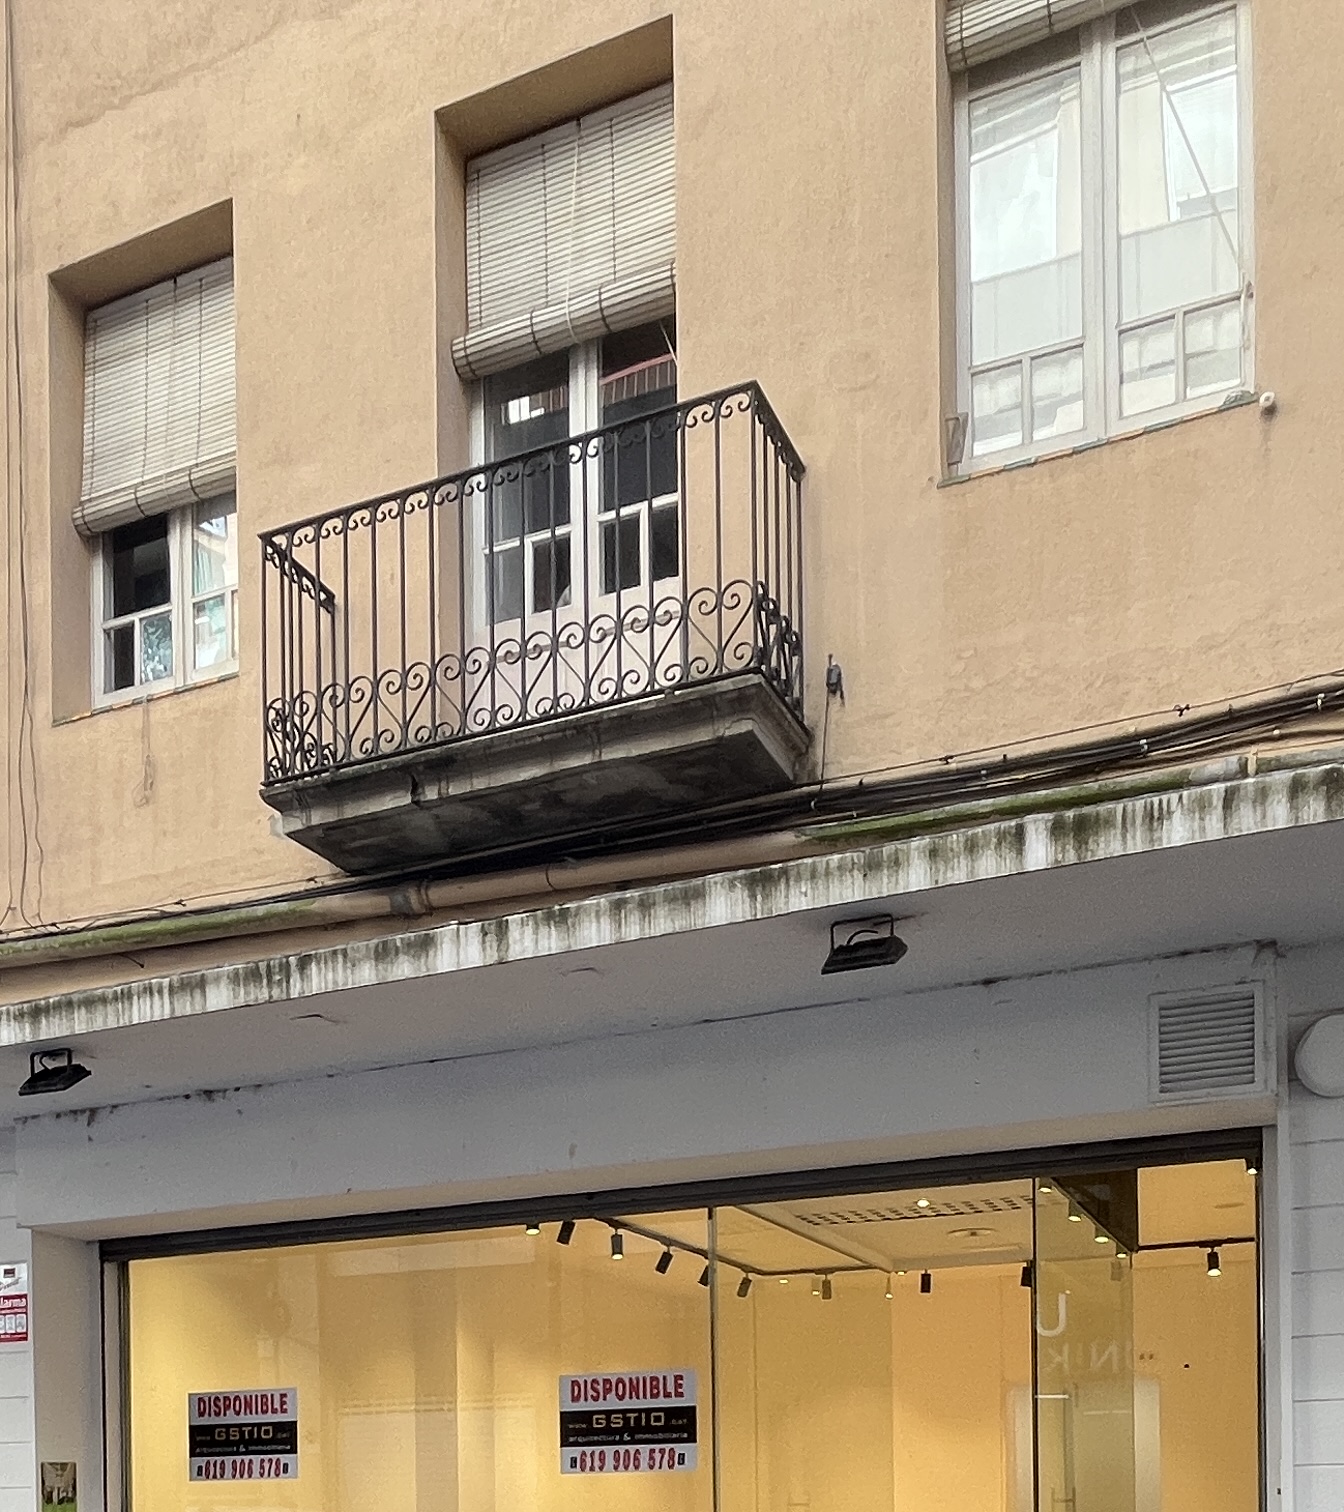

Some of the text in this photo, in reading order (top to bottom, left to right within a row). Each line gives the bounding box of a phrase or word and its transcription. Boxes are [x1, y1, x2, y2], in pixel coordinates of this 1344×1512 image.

[570, 1374, 685, 1404] DISPONIBLE
[197, 1392, 288, 1419] DISPONIBLE
[592, 1412, 665, 1428] GSTIO
[214, 1425, 273, 1441] GSTIO
[623, 1432, 631, 1441] &
[204, 1457, 282, 1479] 619 906 578
[579, 1447, 676, 1472] 619 906 578
